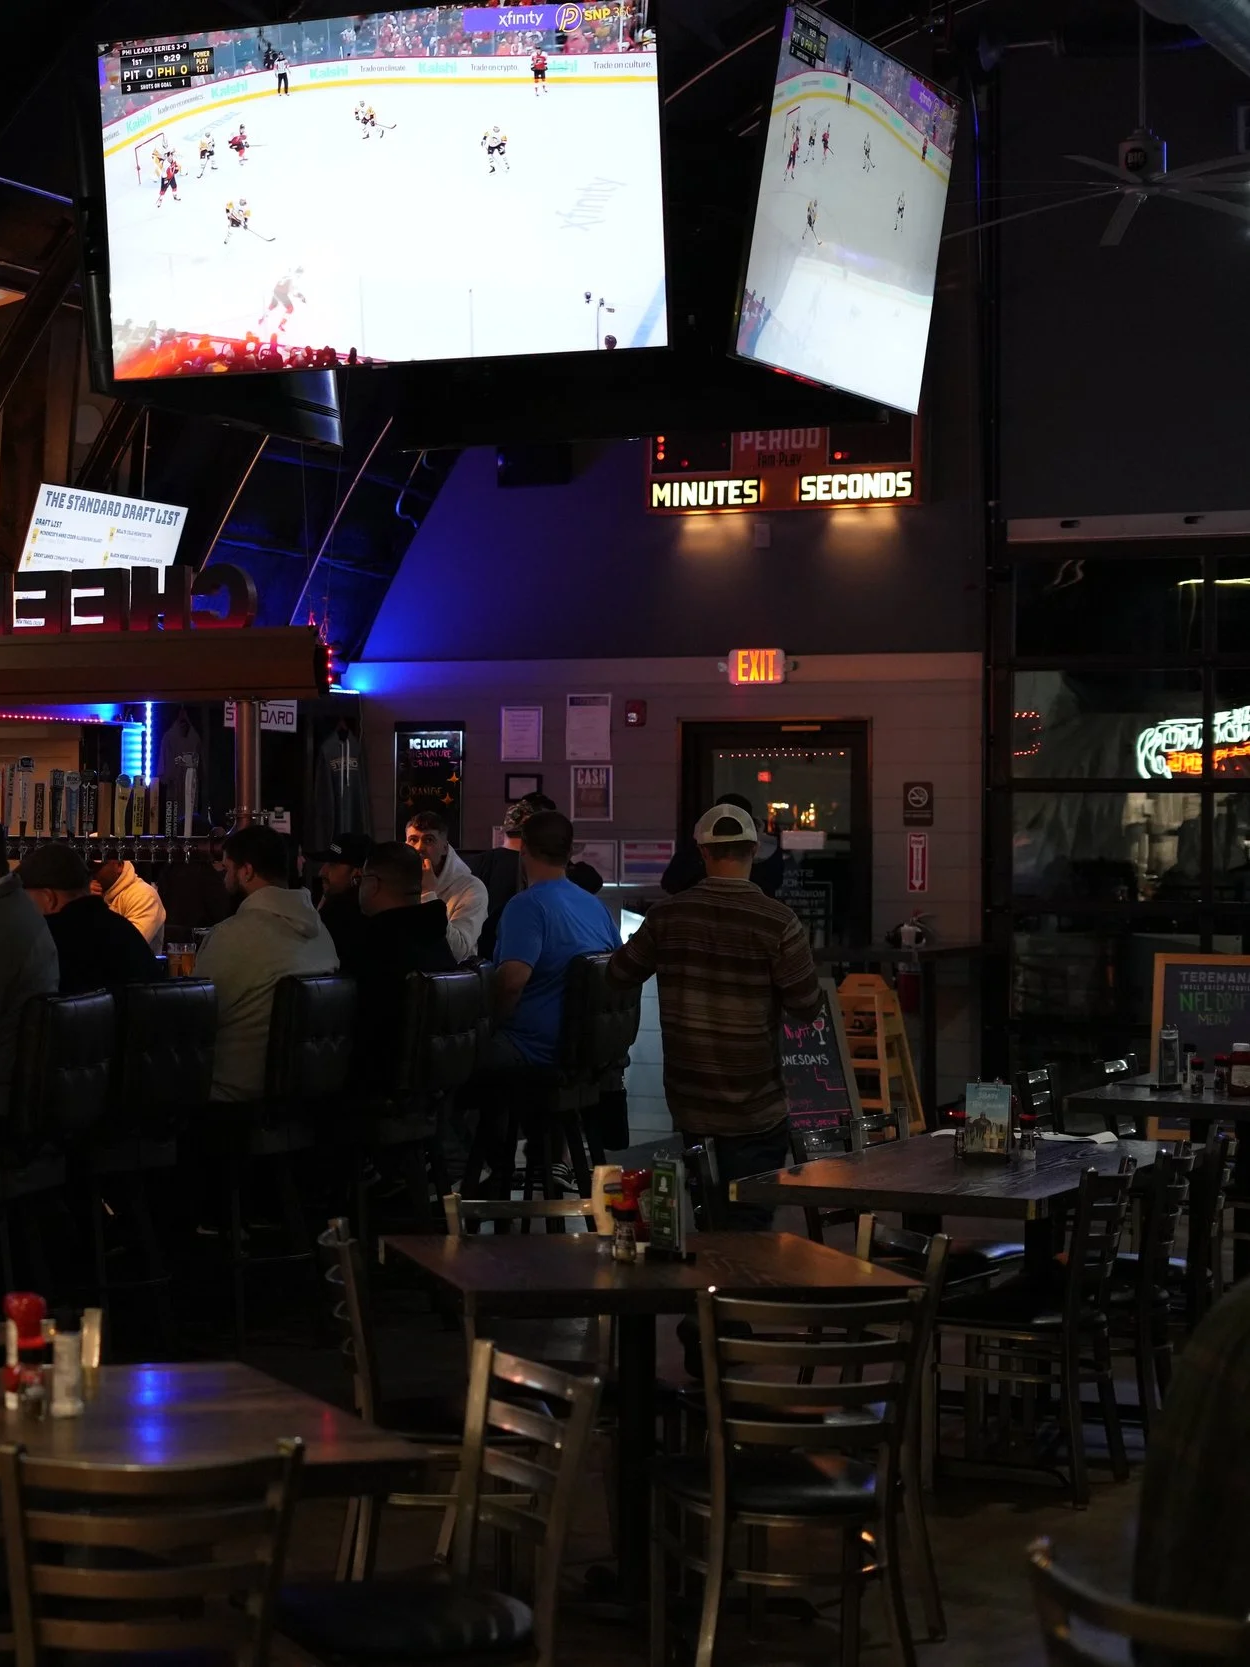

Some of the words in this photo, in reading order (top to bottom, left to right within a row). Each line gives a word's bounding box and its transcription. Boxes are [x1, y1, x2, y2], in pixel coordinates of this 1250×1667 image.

[498, 10, 543, 27] xfinity
[584, 8, 611, 21] SNP
[133, 46, 153, 55] LEADS
[154, 44, 176, 53] SERIES
[176, 43, 187, 51] 3-0
[131, 58, 143, 66] 1ST
[163, 53, 181, 63] 9:29
[593, 61, 614, 69] Trade
[624, 59, 654, 69] culture.
[123, 70, 140, 81] PIT
[146, 68, 154, 78] 0
[157, 66, 176, 77] PHI
[180, 64, 188, 75] 0
[196, 65, 209, 73] 1:21
[310, 64, 348, 80] Kalshi
[359, 65, 376, 73] Trade
[418, 61, 457, 74] Kalshi
[470, 63, 488, 71] Trade
[126, 84, 132, 92] 3
[140, 83, 154, 91] SHOTS
[160, 81, 173, 89] GOAL
[211, 80, 248, 99] Kalshi
[126, 111, 152, 134] Kalshi
[740, 429, 821, 452] PERIOD
[652, 479, 759, 507] MINUTES
[801, 471, 913, 502] SECONDS
[45, 490, 65, 509] THE
[66, 494, 122, 517] STANDARD
[122, 503, 157, 523] DRAFT
[156, 509, 181, 526] LIST
[35, 518, 50, 527] DRAFT
[738, 650, 776, 681] EXIT
[226, 706, 294, 725] SDARD
[409, 738, 421, 750] IC
[422, 739, 449, 749] LIGHT
[412, 760, 440, 768] CRUSH
[576, 768, 607, 786] CASH
[1179, 991, 1216, 1012] NFL
